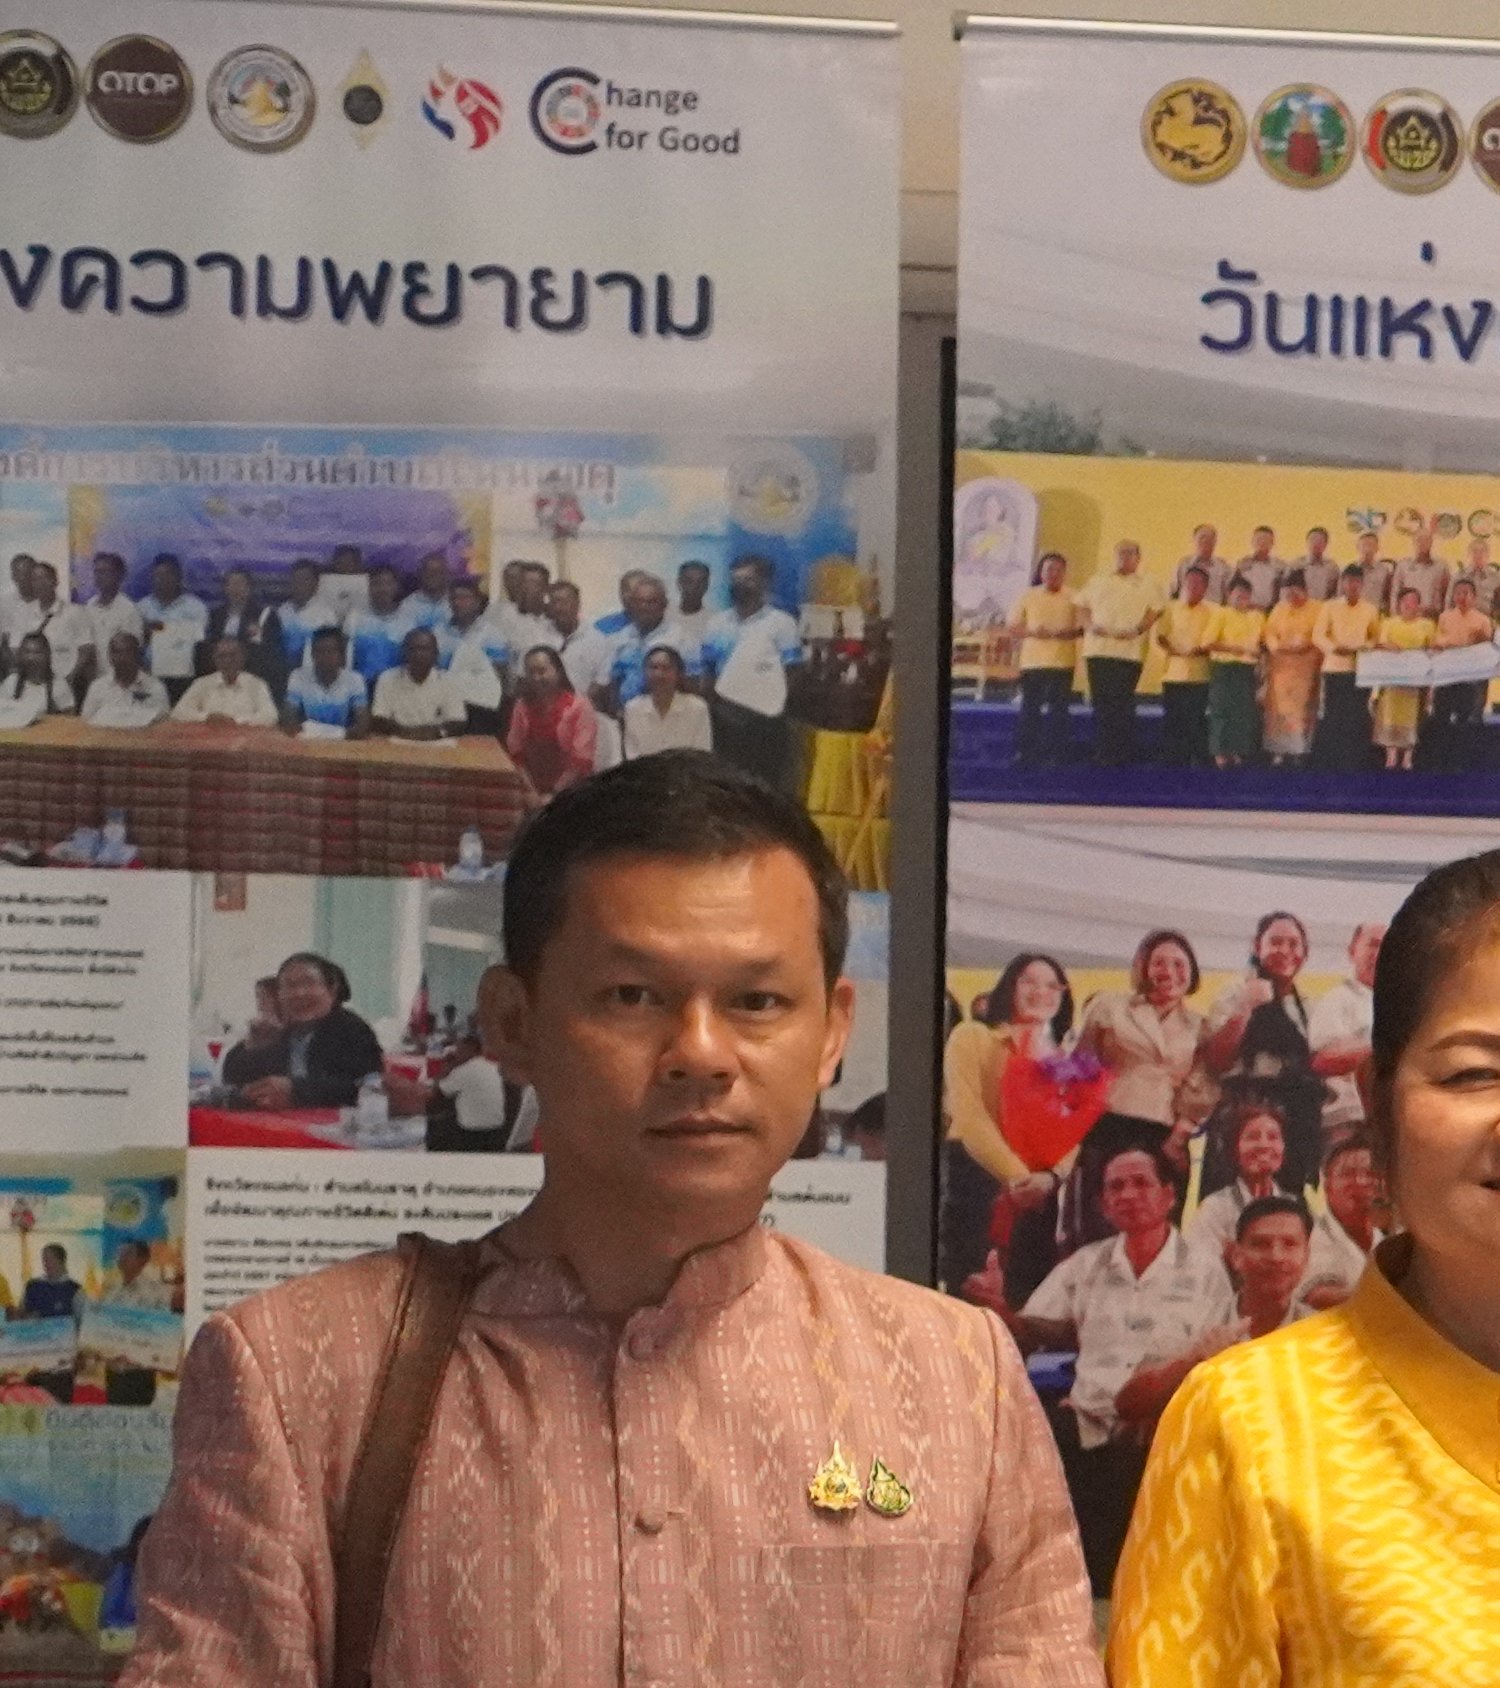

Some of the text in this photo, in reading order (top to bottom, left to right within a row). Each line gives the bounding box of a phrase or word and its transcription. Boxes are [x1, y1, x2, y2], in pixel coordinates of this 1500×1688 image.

[98, 70, 178, 95] OTOP
[605, 122, 740, 155] for Good
